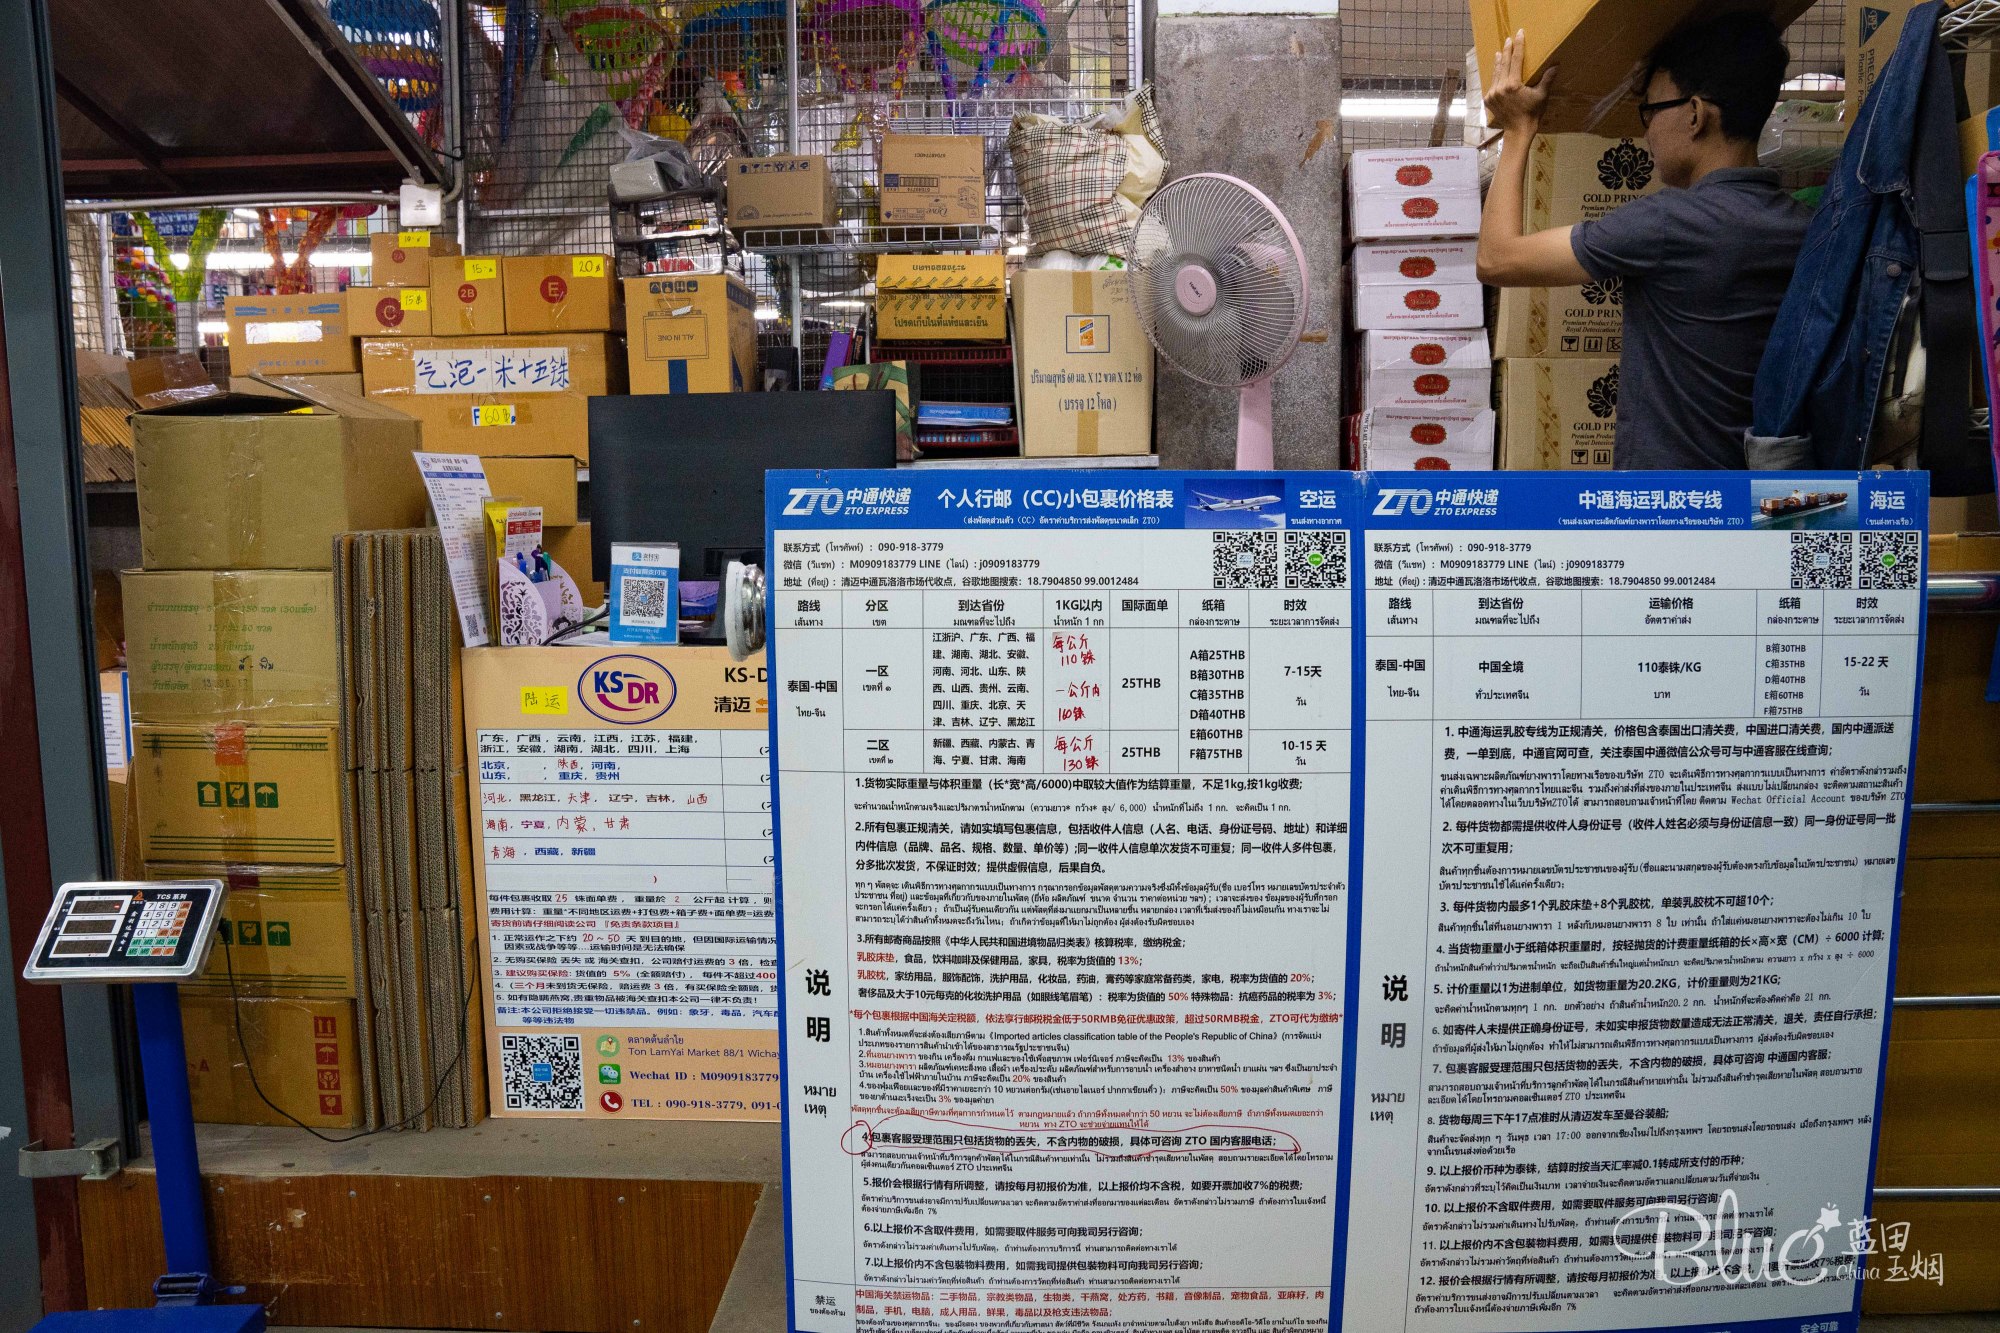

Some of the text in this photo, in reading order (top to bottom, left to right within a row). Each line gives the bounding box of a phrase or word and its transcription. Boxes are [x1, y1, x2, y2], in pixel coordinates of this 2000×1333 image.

[1584, 194, 1611, 202] GOLD
[1565, 309, 1594, 317] GOLD
[1095, 372, 1102, 382] 12
[1125, 372, 1132, 382] 12
[1086, 398, 1094, 409] 12
[782, 488, 844, 515] ZTO
[846, 488, 911, 505] 中通快递
[1299, 490, 1336, 509] 空运
[1372, 489, 1433, 515] ZTO
[1436, 488, 1499, 506] 中通快递
[1579, 490, 1722, 510] 中通海运乳胶专线
[1870, 491, 1905, 510] 海运
[845, 507, 909, 515] ZTO EXPRESS
[1434, 507, 1497, 515] ZTO EXPRESS
[783, 543, 943, 553] 联系方式 090-918-3779
[1468, 543, 1531, 552] 090-918-3779
[783, 560, 940, 570] 微信 M0909183779 LINE
[1441, 560, 1528, 569] M0909183779 LINE
[783, 577, 802, 587] 地址
[1085, 577, 1139, 586] 99.0012484
[1664, 576, 1715, 585] 99.0012484
[798, 600, 1307, 611] 路线 分区 到达省份 1KG以内 国际面单 纸箱 时效
[1389, 598, 1878, 609] 路线 到达省份 运输价格 纸箱 时效
[1190, 650, 1245, 661] A箱25THB
[1375, 659, 1425, 671] 泰国-中国
[1479, 661, 1524, 673] 中国全境
[1638, 661, 1701, 673] 110泰铢/KG
[1844, 657, 1888, 667] 15-22 天
[866, 665, 888, 677] 一区
[1190, 670, 1244, 680] B箱30THB
[594, 671, 659, 704] KS DR
[788, 681, 837, 692] 泰国-中国
[1122, 678, 1161, 688] 25THB
[1190, 690, 1244, 700] C箱35THB
[714, 696, 751, 713] 清迈
[1190, 709, 1245, 719] D箱40THB
[1190, 729, 1243, 739] E箱60THB
[867, 740, 889, 751] 二区
[1282, 741, 1326, 751] 10-15 天
[1122, 748, 1161, 757] 25THB
[1190, 749, 1243, 759] F箱75THB
[1835, 933, 1859, 942] 6000
[805, 969, 831, 996] 说
[1382, 974, 1408, 1002] 说
[1169, 992, 1188, 1001] 50%
[807, 1016, 831, 1042] 明
[1064, 1032, 1115, 1040] classification
[1118, 1032, 1137, 1040] table
[1202, 1032, 1237, 1041] Republic
[1381, 1023, 1406, 1049] 明
[628, 1047, 744, 1058] Ton LamYai Market 88/1
[630, 1071, 778, 1082] Wechat ID M0909183779
[632, 1098, 653, 1108] TEL
[1185, 1136, 1206, 1145] ZTO
[815, 1295, 836, 1306] 禁运
